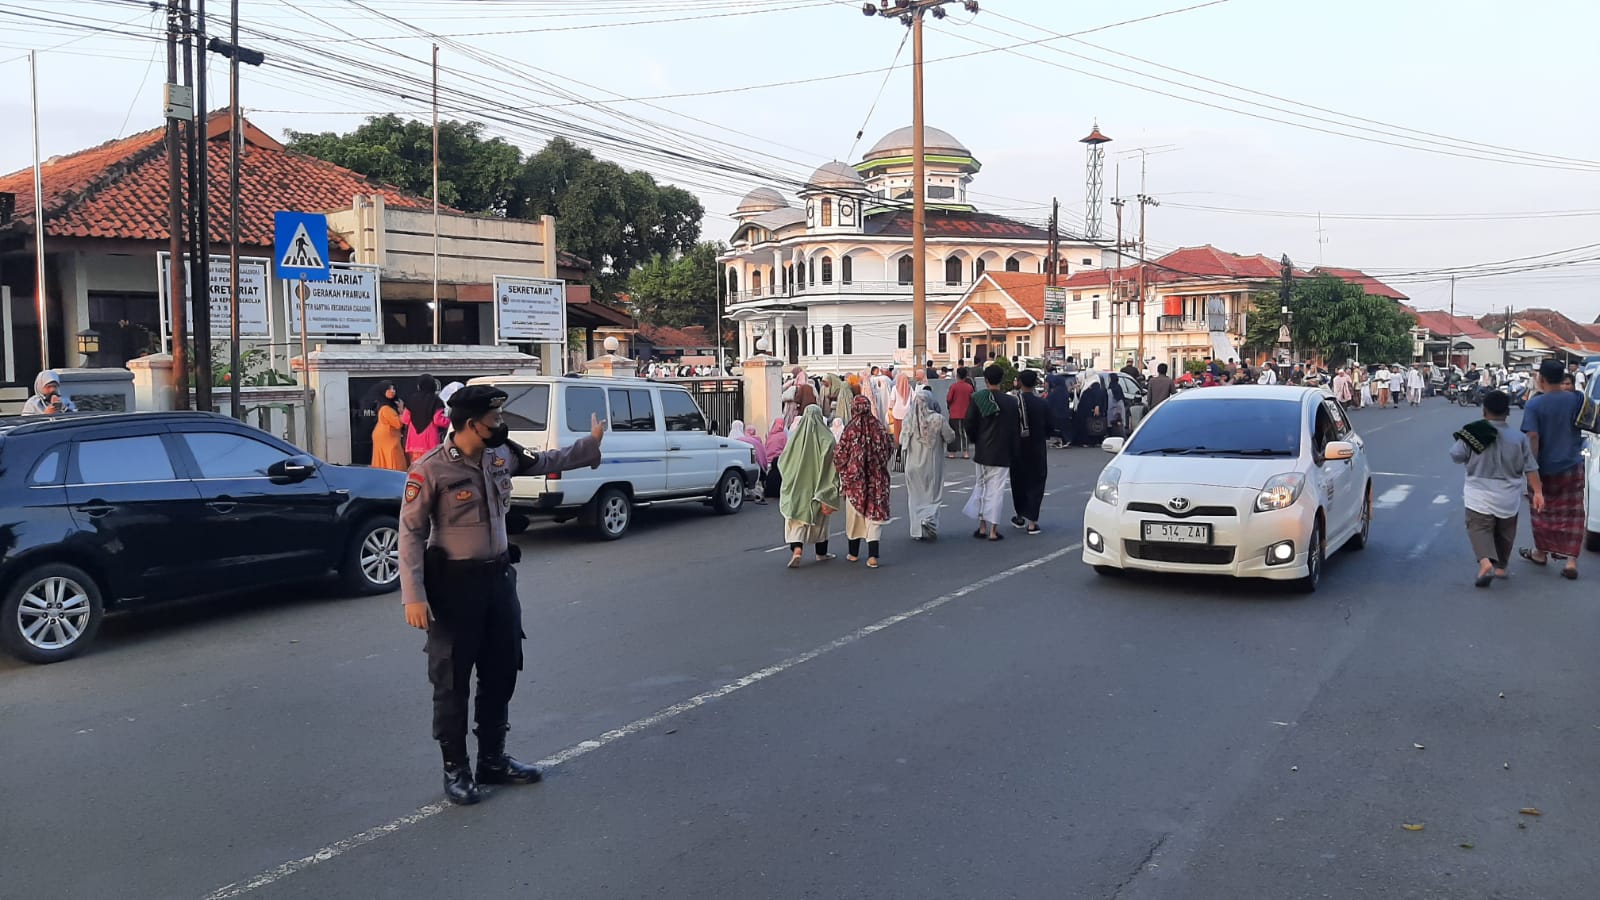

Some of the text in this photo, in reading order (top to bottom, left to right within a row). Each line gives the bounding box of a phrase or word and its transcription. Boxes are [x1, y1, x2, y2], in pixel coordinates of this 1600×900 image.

[312, 288, 370, 299] GERAKAN PRAMUKA
[508, 285, 552, 296] SEKRETARIAT
[1146, 525, 1151, 535] B
[1162, 525, 1179, 536] 514
